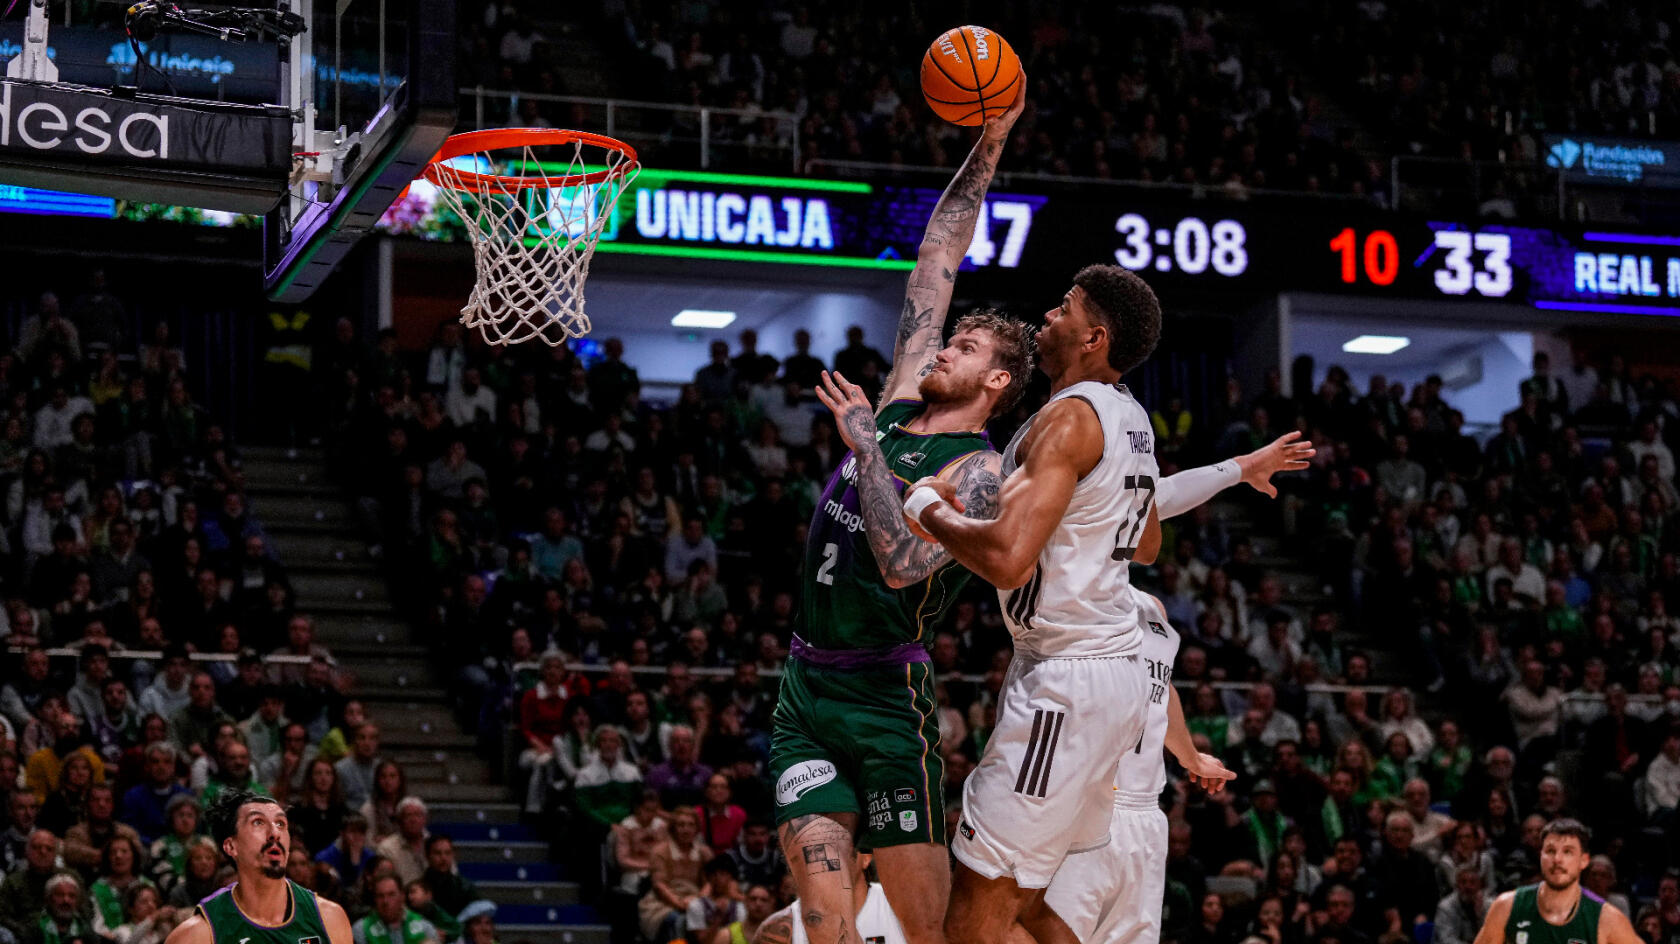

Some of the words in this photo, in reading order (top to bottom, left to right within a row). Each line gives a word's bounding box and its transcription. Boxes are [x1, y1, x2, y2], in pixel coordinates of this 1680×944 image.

[636, 188, 834, 250] UNICAJA
[1114, 213, 1248, 277] 3:08
[1329, 227, 1399, 286] 10
[1434, 230, 1513, 297] 33
[1574, 252, 1660, 297] REAL
[816, 543, 838, 586] 2
[868, 811, 895, 831] aga
[897, 793, 912, 801] acb
